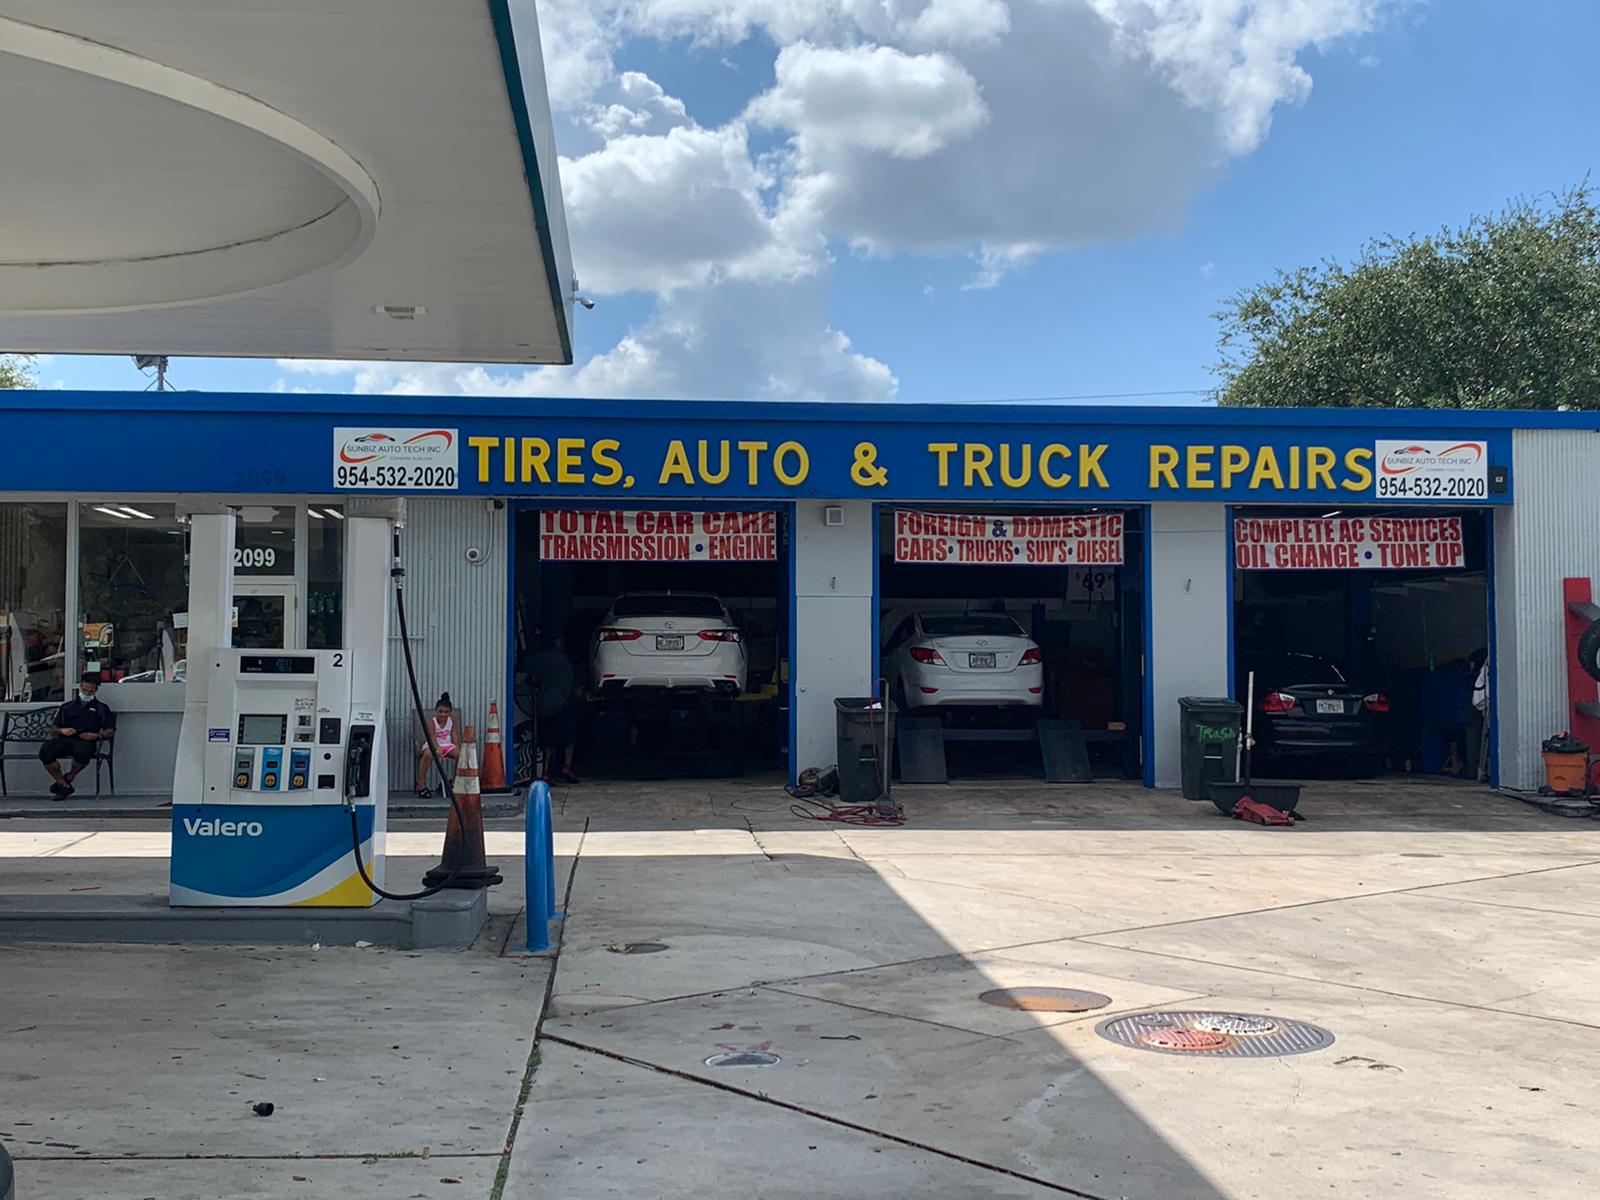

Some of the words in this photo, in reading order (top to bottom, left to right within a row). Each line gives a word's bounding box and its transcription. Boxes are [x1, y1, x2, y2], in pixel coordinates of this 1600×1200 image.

[347, 445, 376, 453] SUNBIZ
[378, 445, 401, 453] AUTO
[468, 436, 635, 488] TIRES,
[658, 440, 810, 486] AUTO
[851, 441, 888, 487] &
[928, 443, 1110, 488] TRUCK
[1149, 445, 1373, 491] REPAIRS
[1387, 457, 1414, 465] SUNBIZ
[1415, 457, 1436, 465] AUTO
[337, 466, 455, 487] 954-532-2020
[1379, 477, 1485, 497] 954-532-2020
[541, 510, 628, 534] TOTAL
[636, 511, 694, 534] CAR
[702, 511, 775, 535] CARE
[897, 512, 987, 537] FOREIGN
[991, 519, 1007, 538] &
[1013, 515, 1122, 538] DOMESTIC
[1235, 519, 1334, 543] COMPLETE
[1339, 519, 1364, 543] AC
[1369, 518, 1461, 542] SERVICES
[233, 548, 276, 567] 2099
[542, 535, 690, 560] TRANSMISSION
[708, 535, 775, 560] ENGINE
[896, 537, 948, 561] CARS
[957, 539, 1014, 562] TRUCKS
[1026, 539, 1067, 563] SUV'S
[1076, 540, 1122, 563] DIESEL
[1236, 544, 1269, 569] OIL
[1274, 544, 1359, 568] CHANGE
[1377, 543, 1430, 568] TUNE
[1436, 543, 1463, 567] UP
[332, 653, 343, 668] 2
[183, 818, 263, 836] Valero
